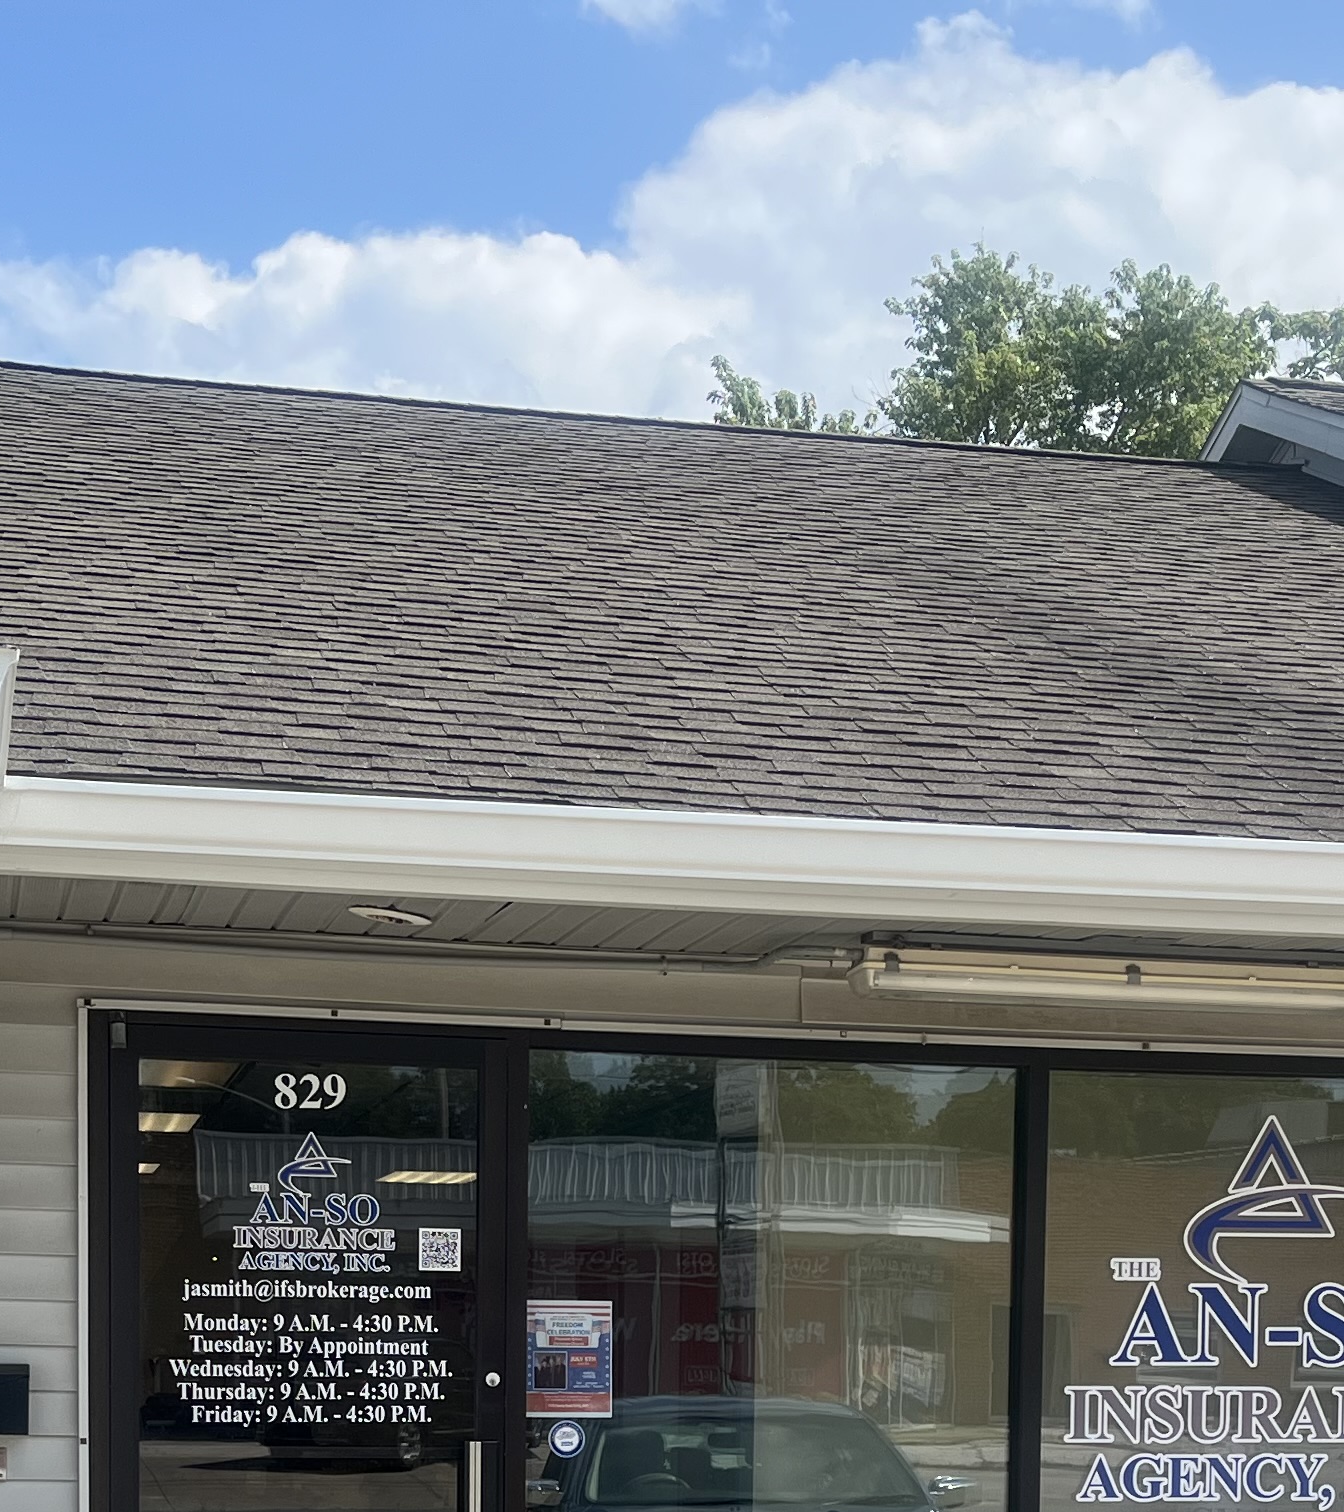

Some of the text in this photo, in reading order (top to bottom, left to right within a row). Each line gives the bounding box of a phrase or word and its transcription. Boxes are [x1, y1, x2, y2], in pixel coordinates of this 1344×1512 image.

[274, 1073, 347, 1110] 829
[250, 1193, 380, 1226] AN-SO
[233, 1227, 396, 1251] INSURANCE
[238, 1251, 391, 1274] AGENCY, INC.
[1110, 1257, 1161, 1281] THE
[182, 1279, 432, 1302] jasmith@ifsbrokerage.com
[183, 1313, 268, 1335] Monday:
[274, 1314, 285, 1332] 9
[289, 1315, 336, 1332] A.M.
[353, 1315, 392, 1333] 4:30
[398, 1315, 439, 1333] P.M.
[190, 1335, 429, 1358] Tuesday: By Appointment
[169, 1360, 283, 1382] Wednesday:
[288, 1360, 299, 1378] 9
[303, 1361, 350, 1378] A.M.
[367, 1361, 406, 1379] 4:30
[412, 1361, 453, 1379] P.M.
[176, 1382, 275, 1405] Thursday:
[280, 1383, 291, 1401] 9
[295, 1384, 342, 1401] A.M.
[359, 1384, 398, 1402] 4:30
[405, 1384, 446, 1402] P.M.
[191, 1405, 261, 1427] Friday:
[267, 1405, 277, 1423] 9
[281, 1406, 329, 1423] A.M.
[346, 1406, 385, 1424] 4:30
[391, 1406, 432, 1424] P.M.
[1076, 1452, 1335, 1510] AGENCY,
